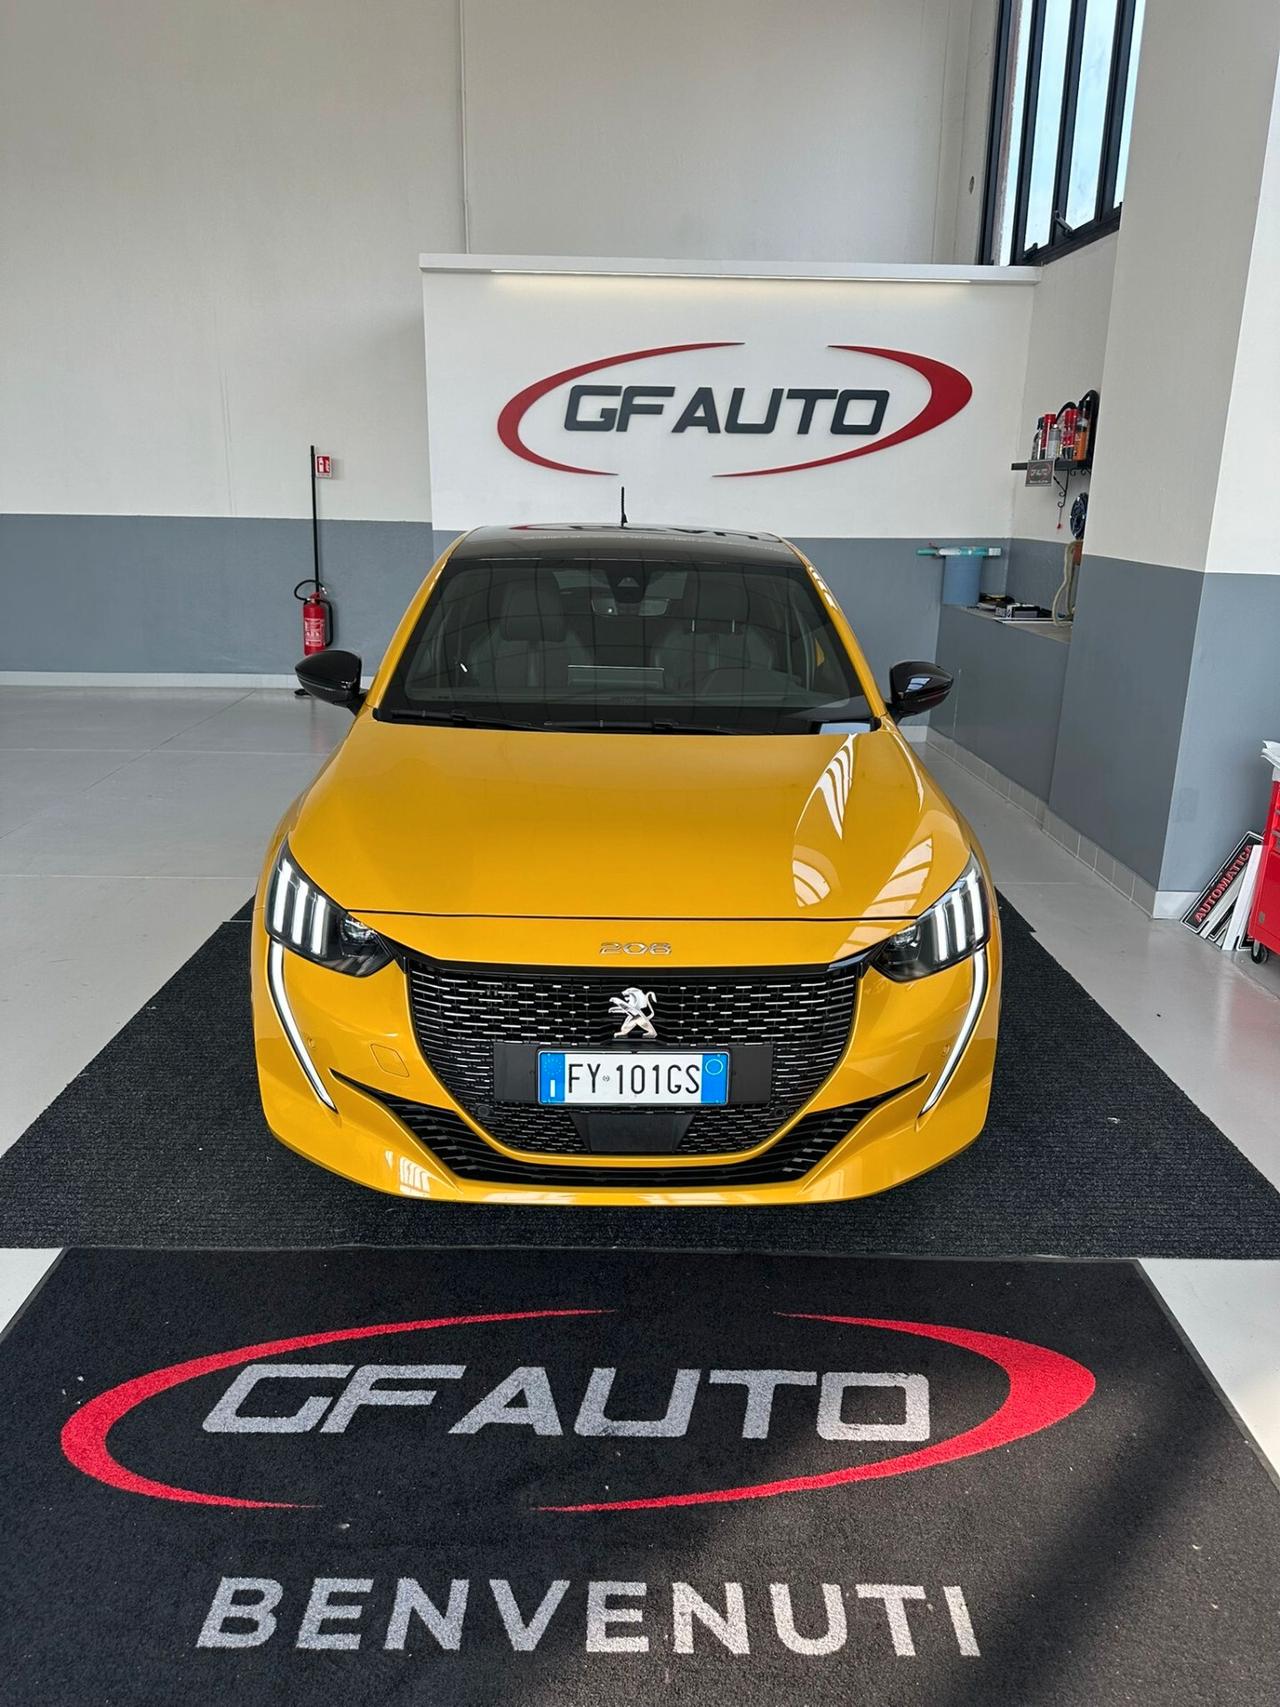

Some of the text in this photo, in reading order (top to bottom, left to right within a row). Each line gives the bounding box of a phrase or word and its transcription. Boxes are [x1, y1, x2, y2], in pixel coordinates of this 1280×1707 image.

[564, 385, 890, 435] GF AUTO
[600, 942, 672, 955] 208
[568, 1063, 601, 1094] FY
[616, 1064, 700, 1095] 101GS
[202, 1363, 932, 1443] GF AUTO
[195, 1576, 982, 1660] BENVENUTI
